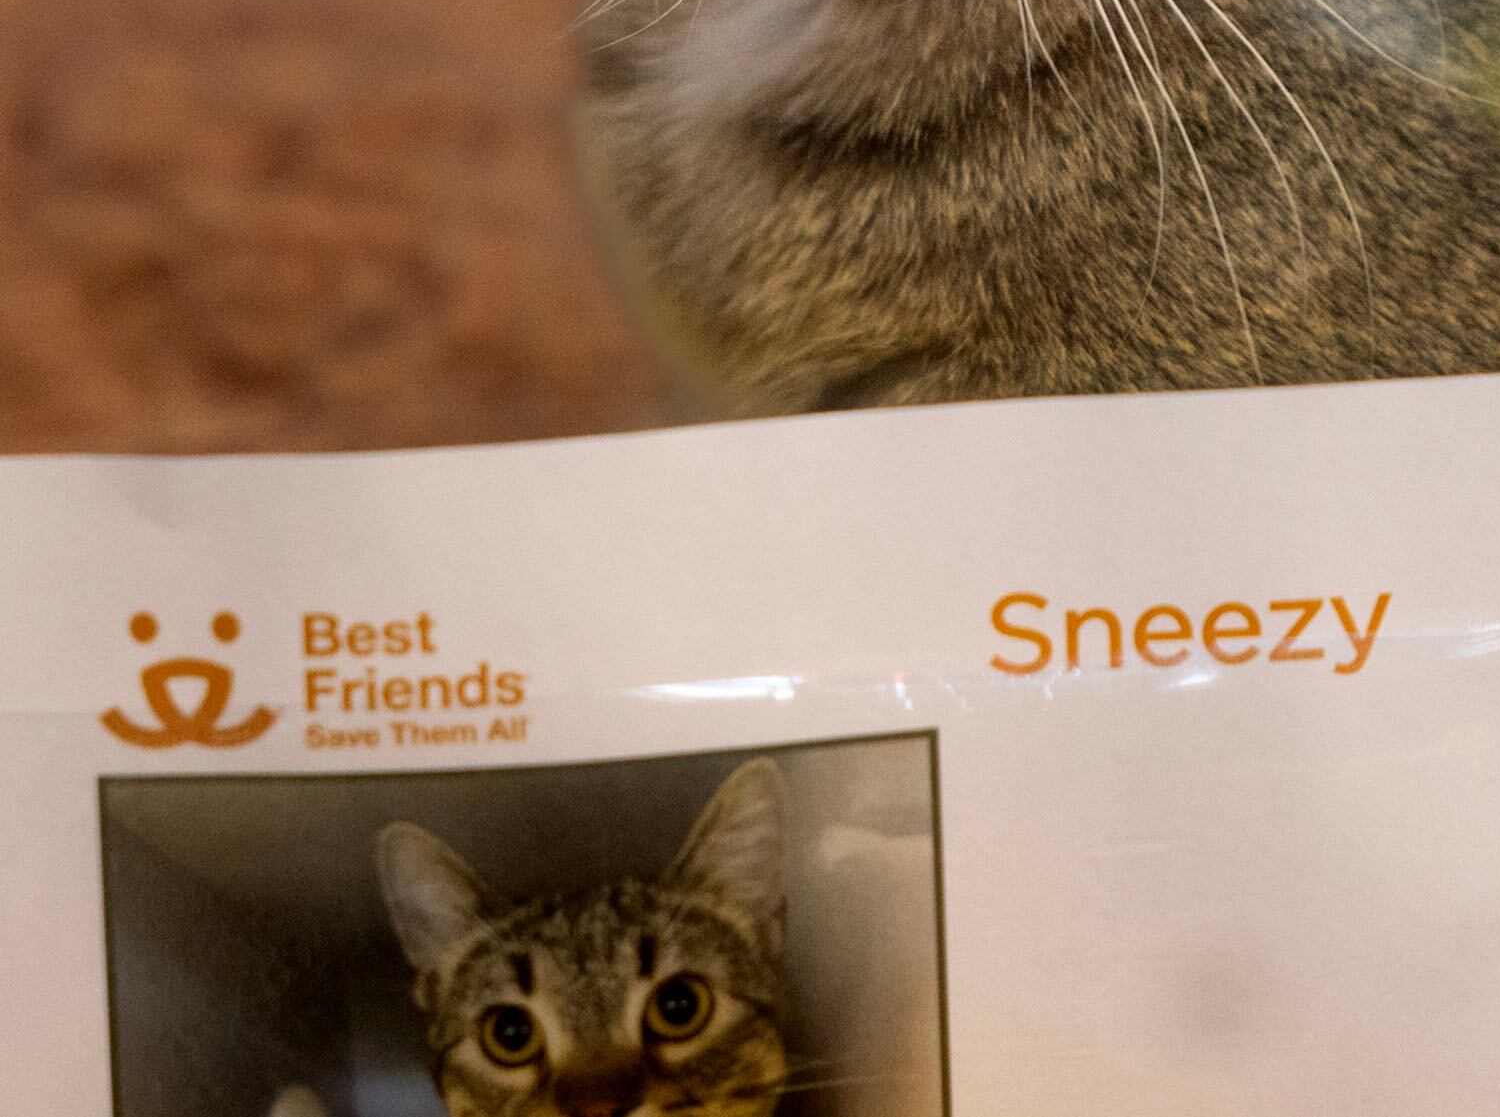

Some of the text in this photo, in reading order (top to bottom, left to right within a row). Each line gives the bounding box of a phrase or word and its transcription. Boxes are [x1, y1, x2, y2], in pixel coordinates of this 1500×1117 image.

[302, 611, 436, 657] Best
[990, 590, 1392, 675] Sneezy
[303, 662, 526, 712] Friends
[306, 717, 527, 749] Save Them All
